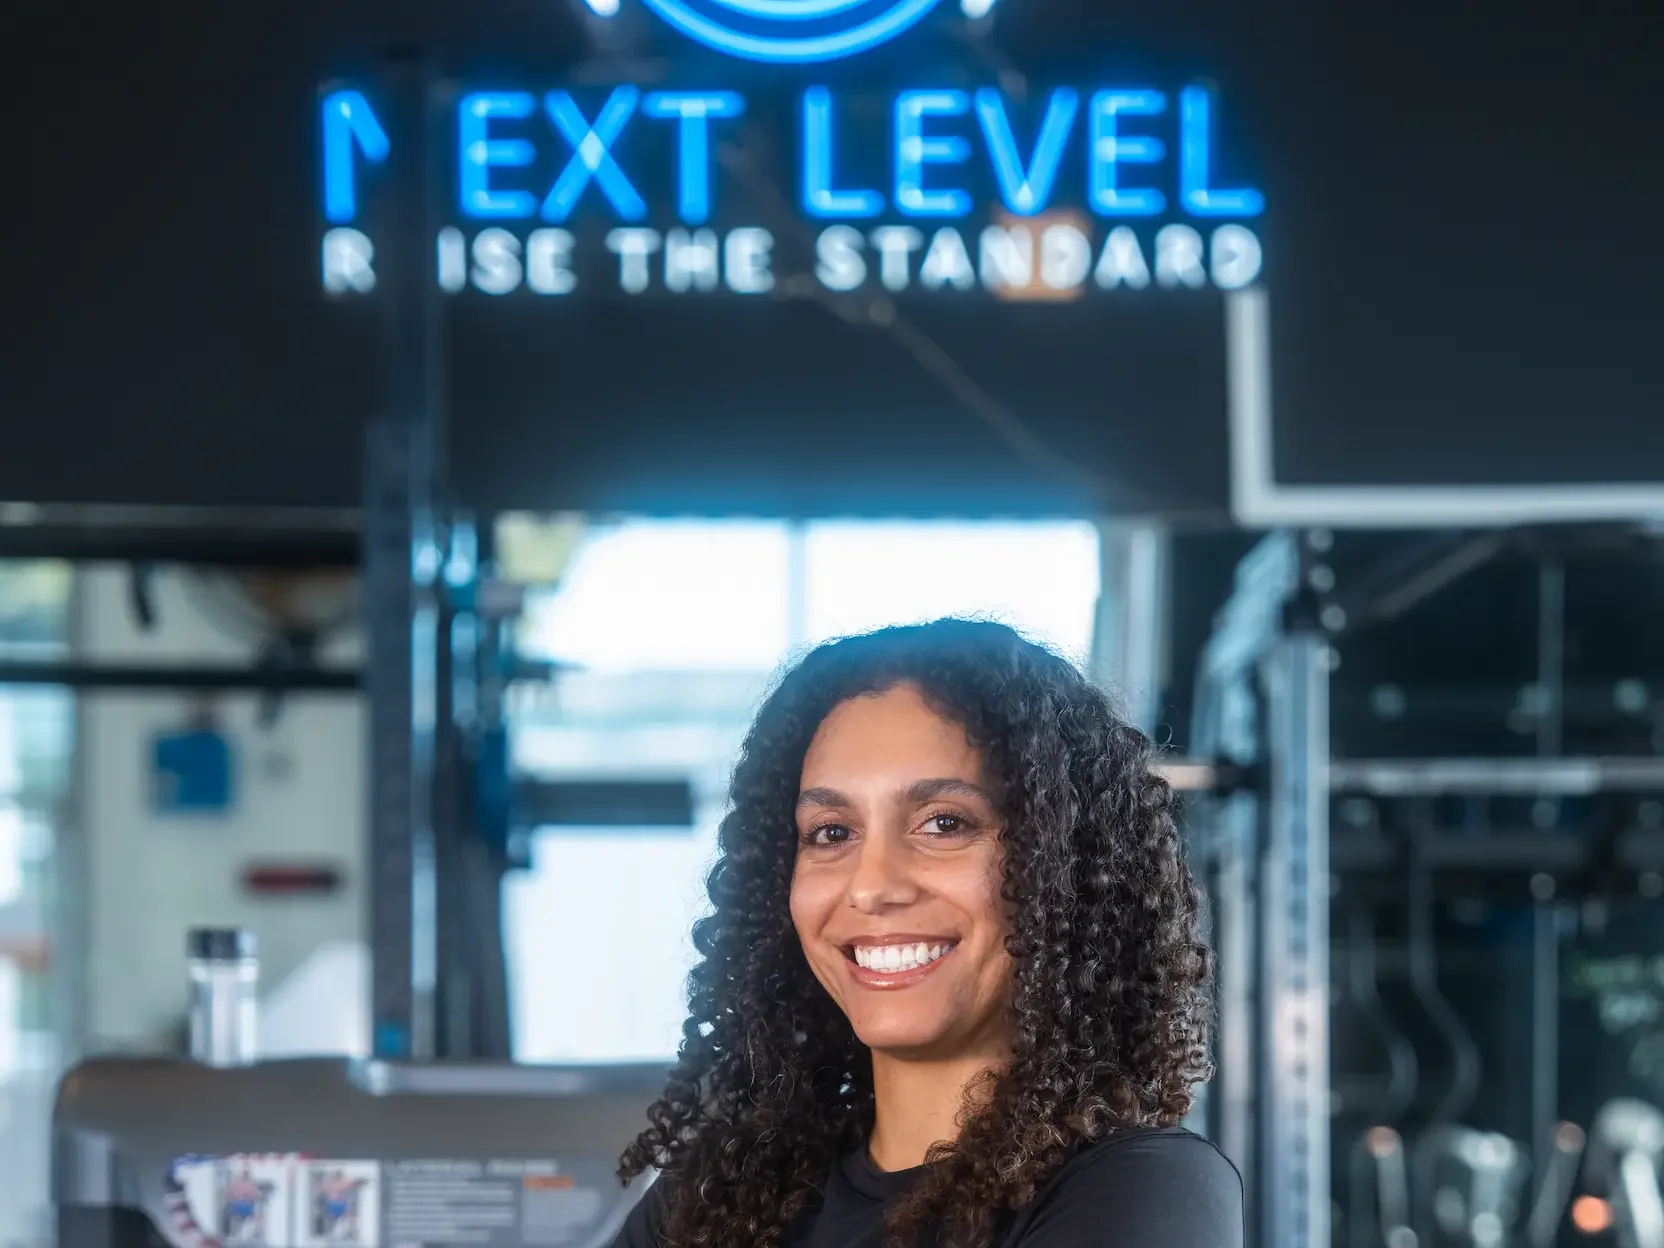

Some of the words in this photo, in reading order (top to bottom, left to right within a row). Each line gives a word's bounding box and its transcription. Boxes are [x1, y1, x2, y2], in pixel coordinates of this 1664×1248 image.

[803, 85, 1265, 218] LEVEL
[322, 225, 578, 295] RISE
[605, 226, 775, 294] THE
[814, 224, 1264, 292] STANDARD
